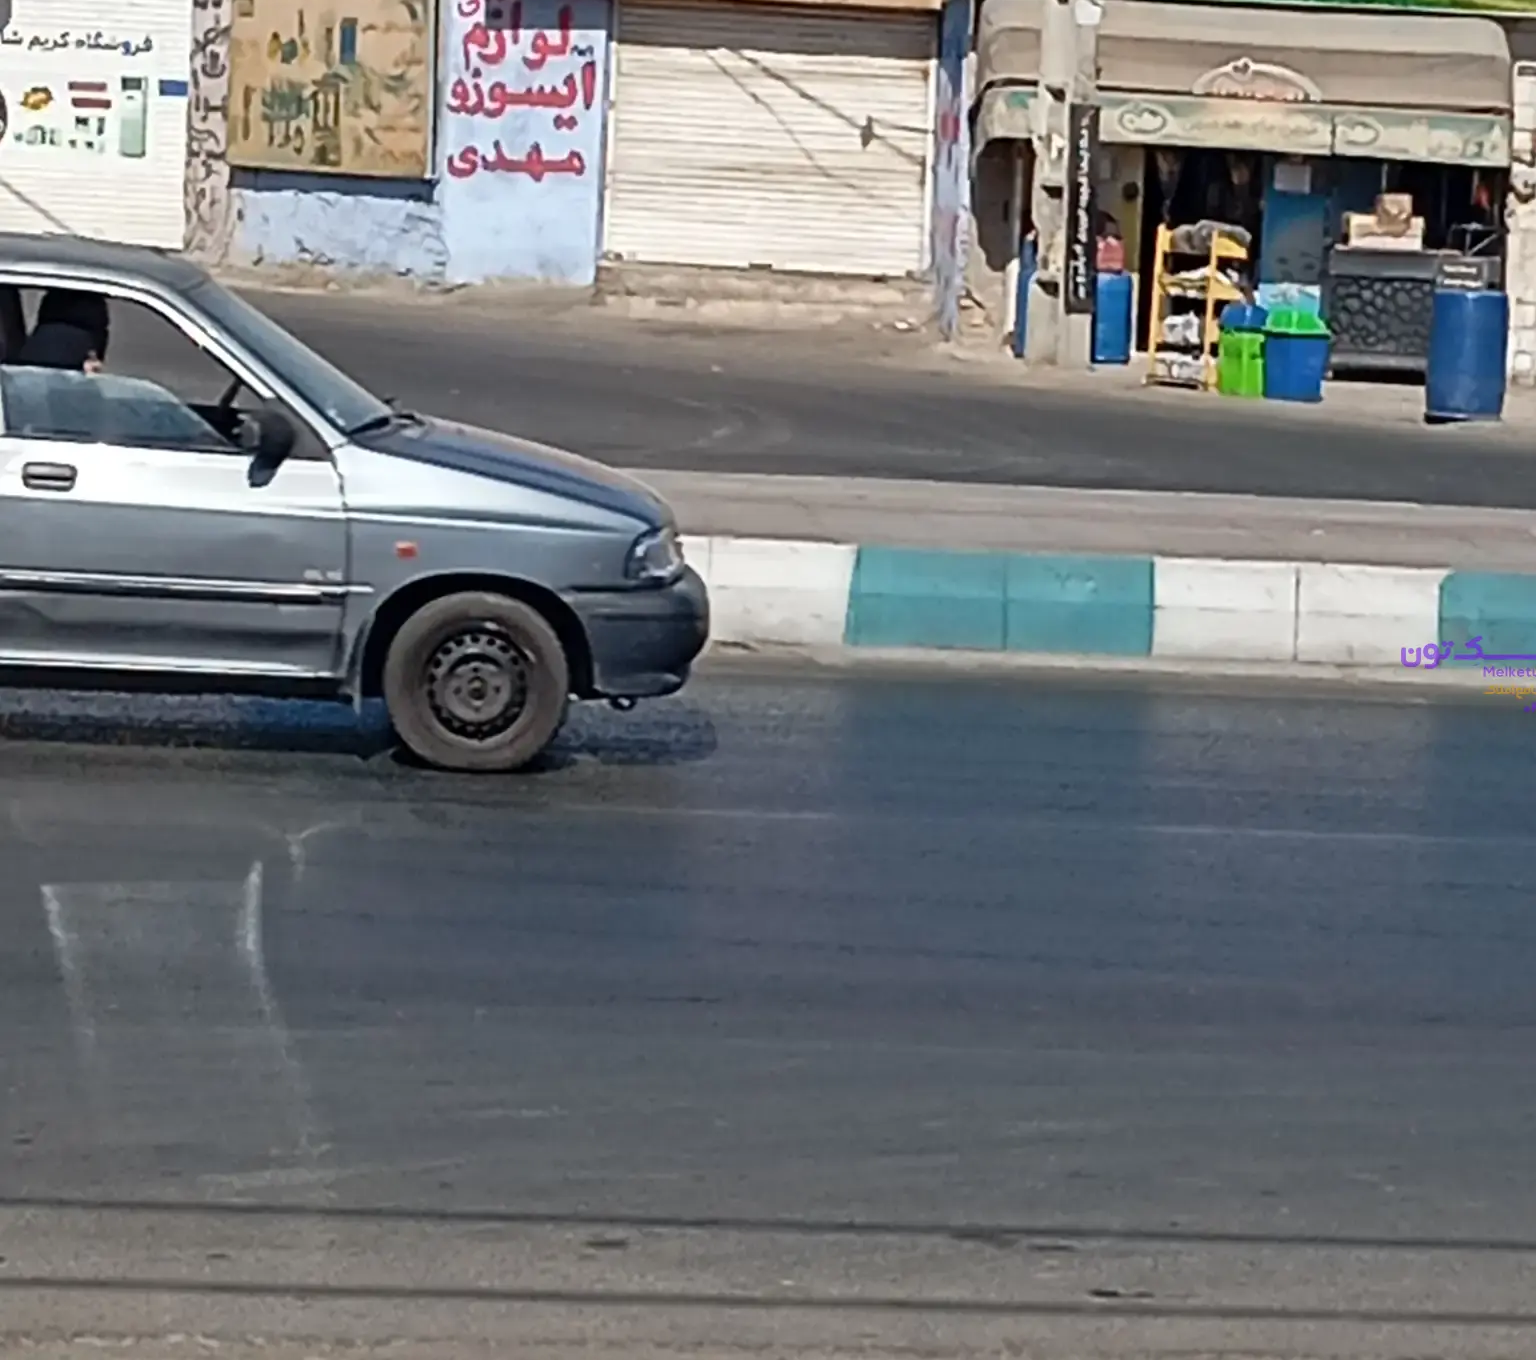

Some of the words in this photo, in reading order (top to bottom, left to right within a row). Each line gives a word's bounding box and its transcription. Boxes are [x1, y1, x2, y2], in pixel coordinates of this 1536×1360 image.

[74, 31, 153, 56] فروشگاه
[463, 1, 574, 72] لوازم
[446, 60, 597, 130] ایسوزو
[447, 140, 586, 183] مهدی
